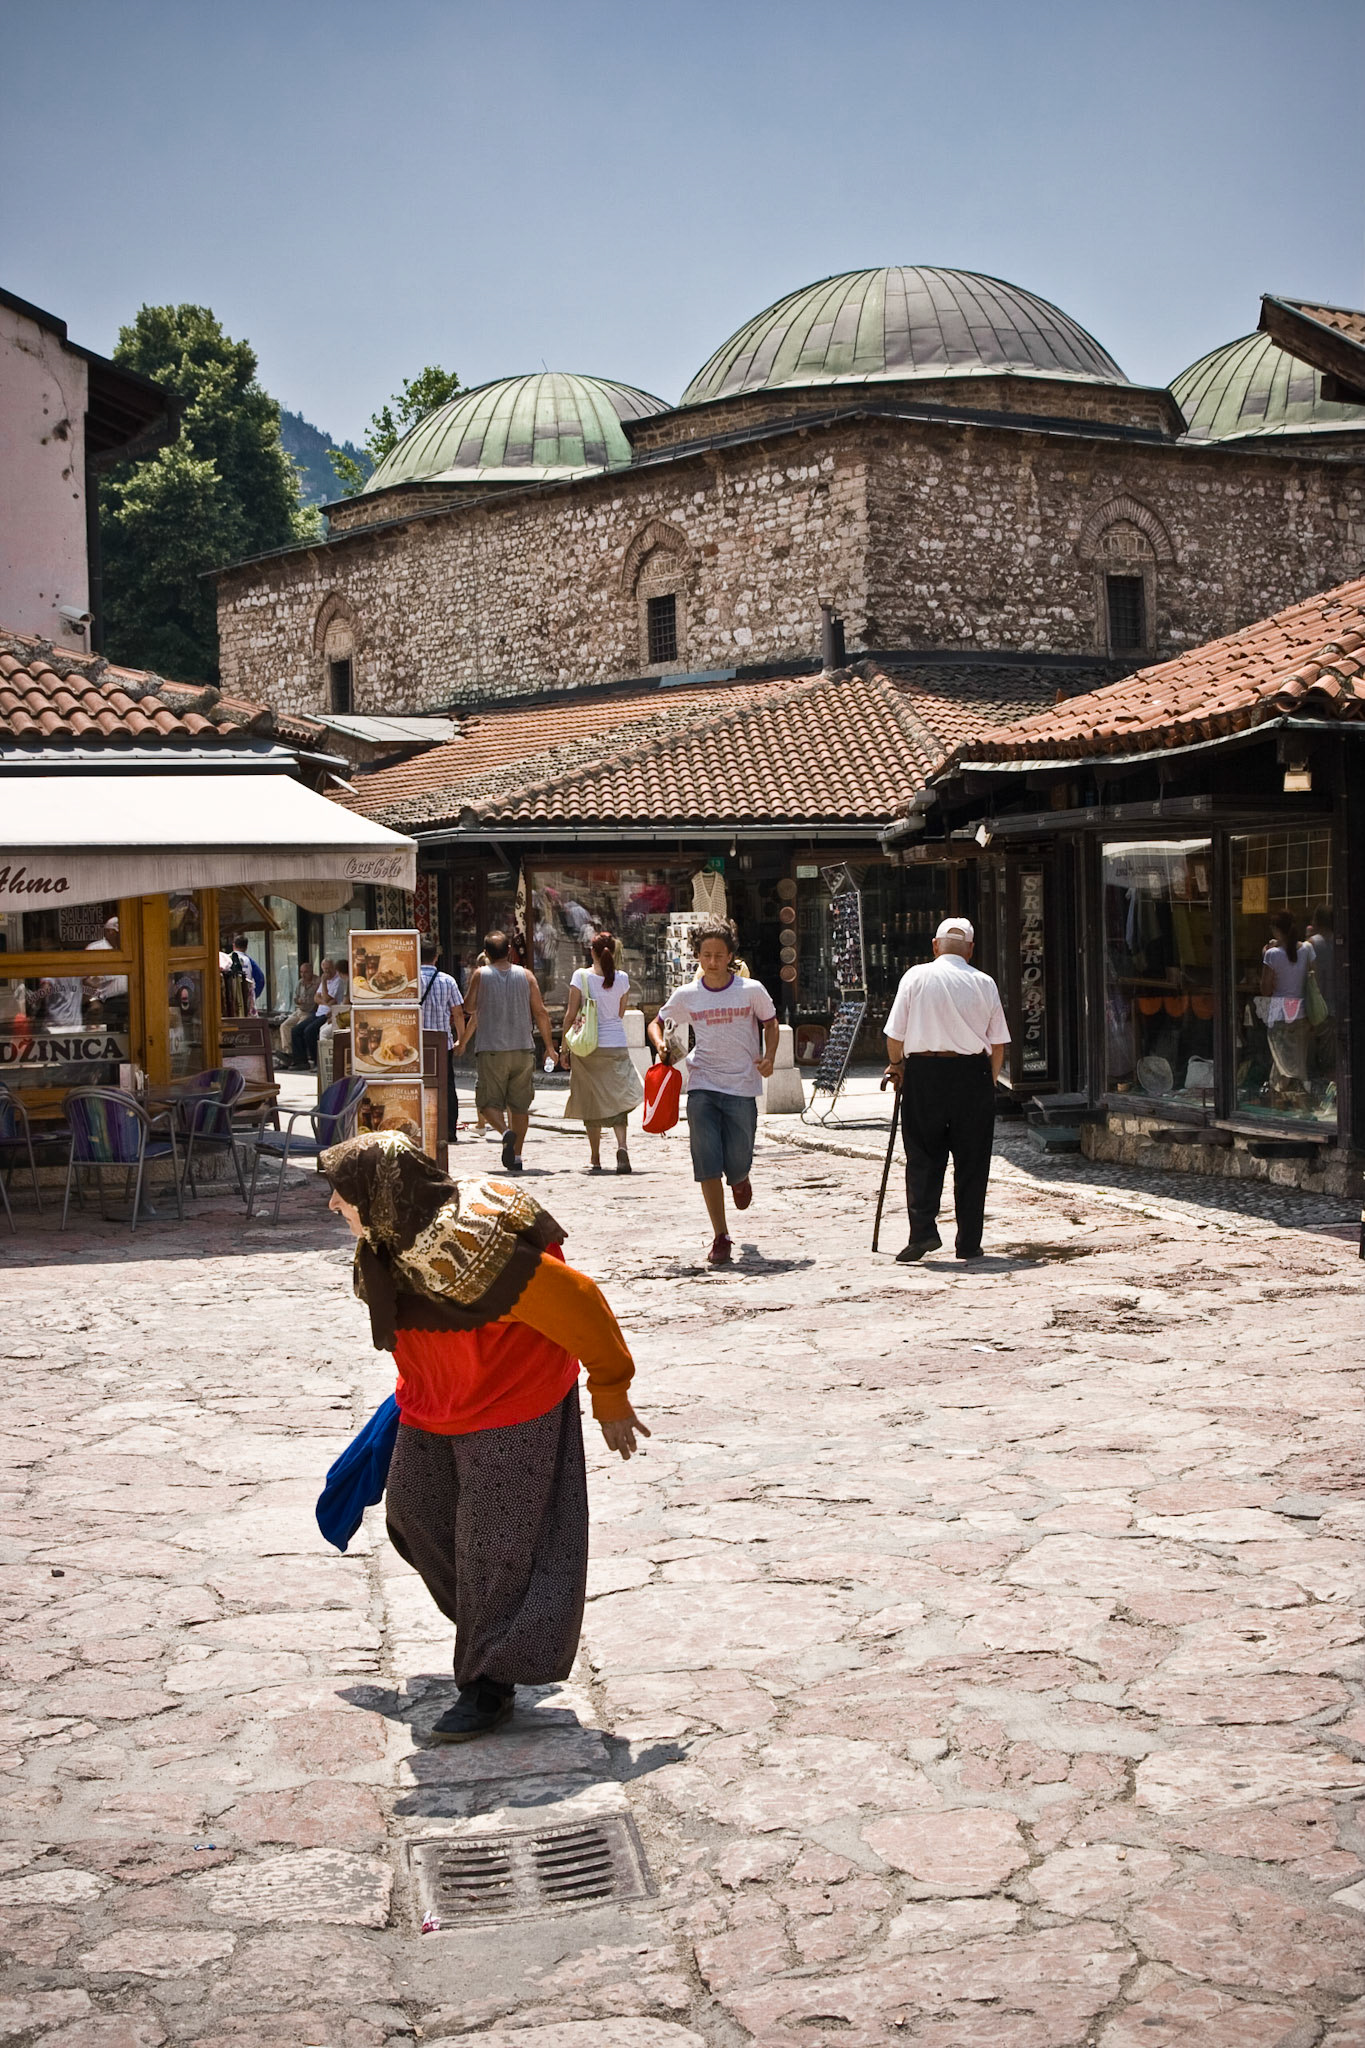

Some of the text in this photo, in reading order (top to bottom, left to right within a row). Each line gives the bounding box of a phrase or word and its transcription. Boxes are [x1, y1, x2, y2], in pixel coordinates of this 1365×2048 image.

[343, 855, 402, 879] Coca-Cola
[60, 906, 104, 924] SALATE
[1022, 875, 1043, 982] SREBRO
[1024, 991, 1042, 1040] 925
